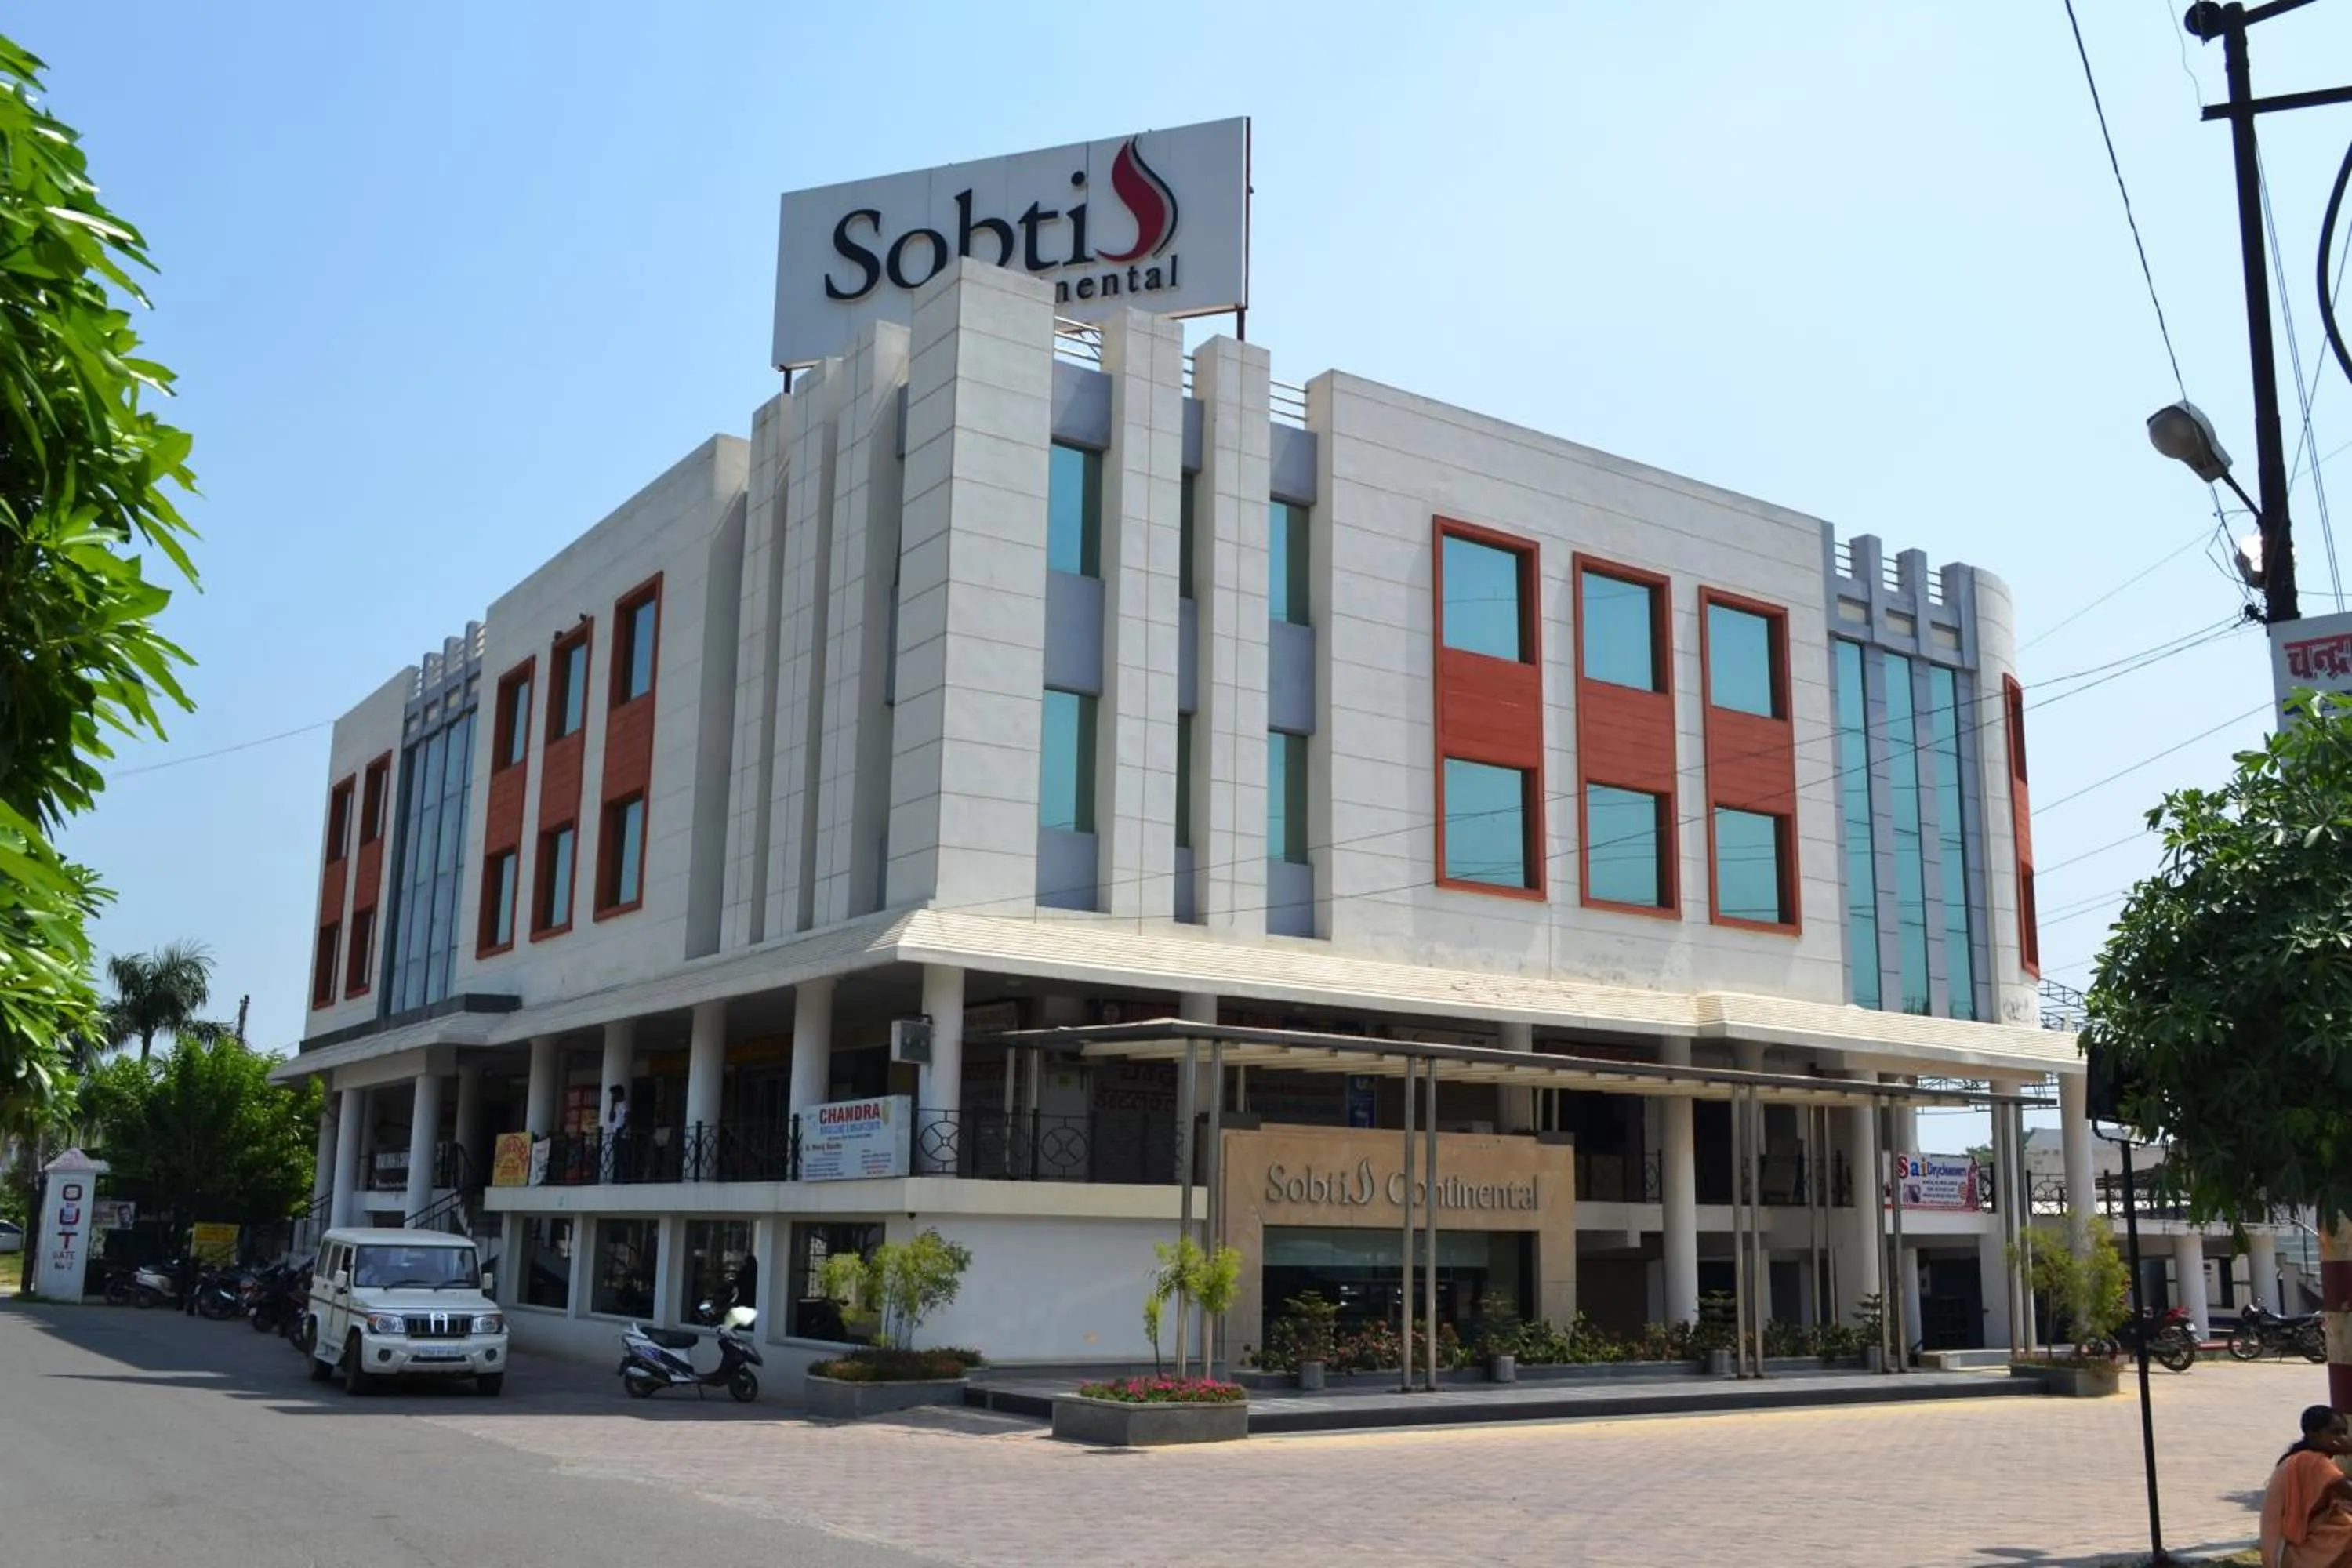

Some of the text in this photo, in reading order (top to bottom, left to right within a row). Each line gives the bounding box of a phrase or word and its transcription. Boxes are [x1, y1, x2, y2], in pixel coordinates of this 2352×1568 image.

[823, 170, 1094, 300] Sobti
[1054, 254, 1178, 303] nental
[818, 1103, 880, 1125] CHANDRA
[1265, 1162, 1539, 1210] Sobti Continental
[1896, 1156, 1926, 1179] Sai
[57, 1184, 82, 1250] OUT
[52, 1250, 76, 1260] GATE
